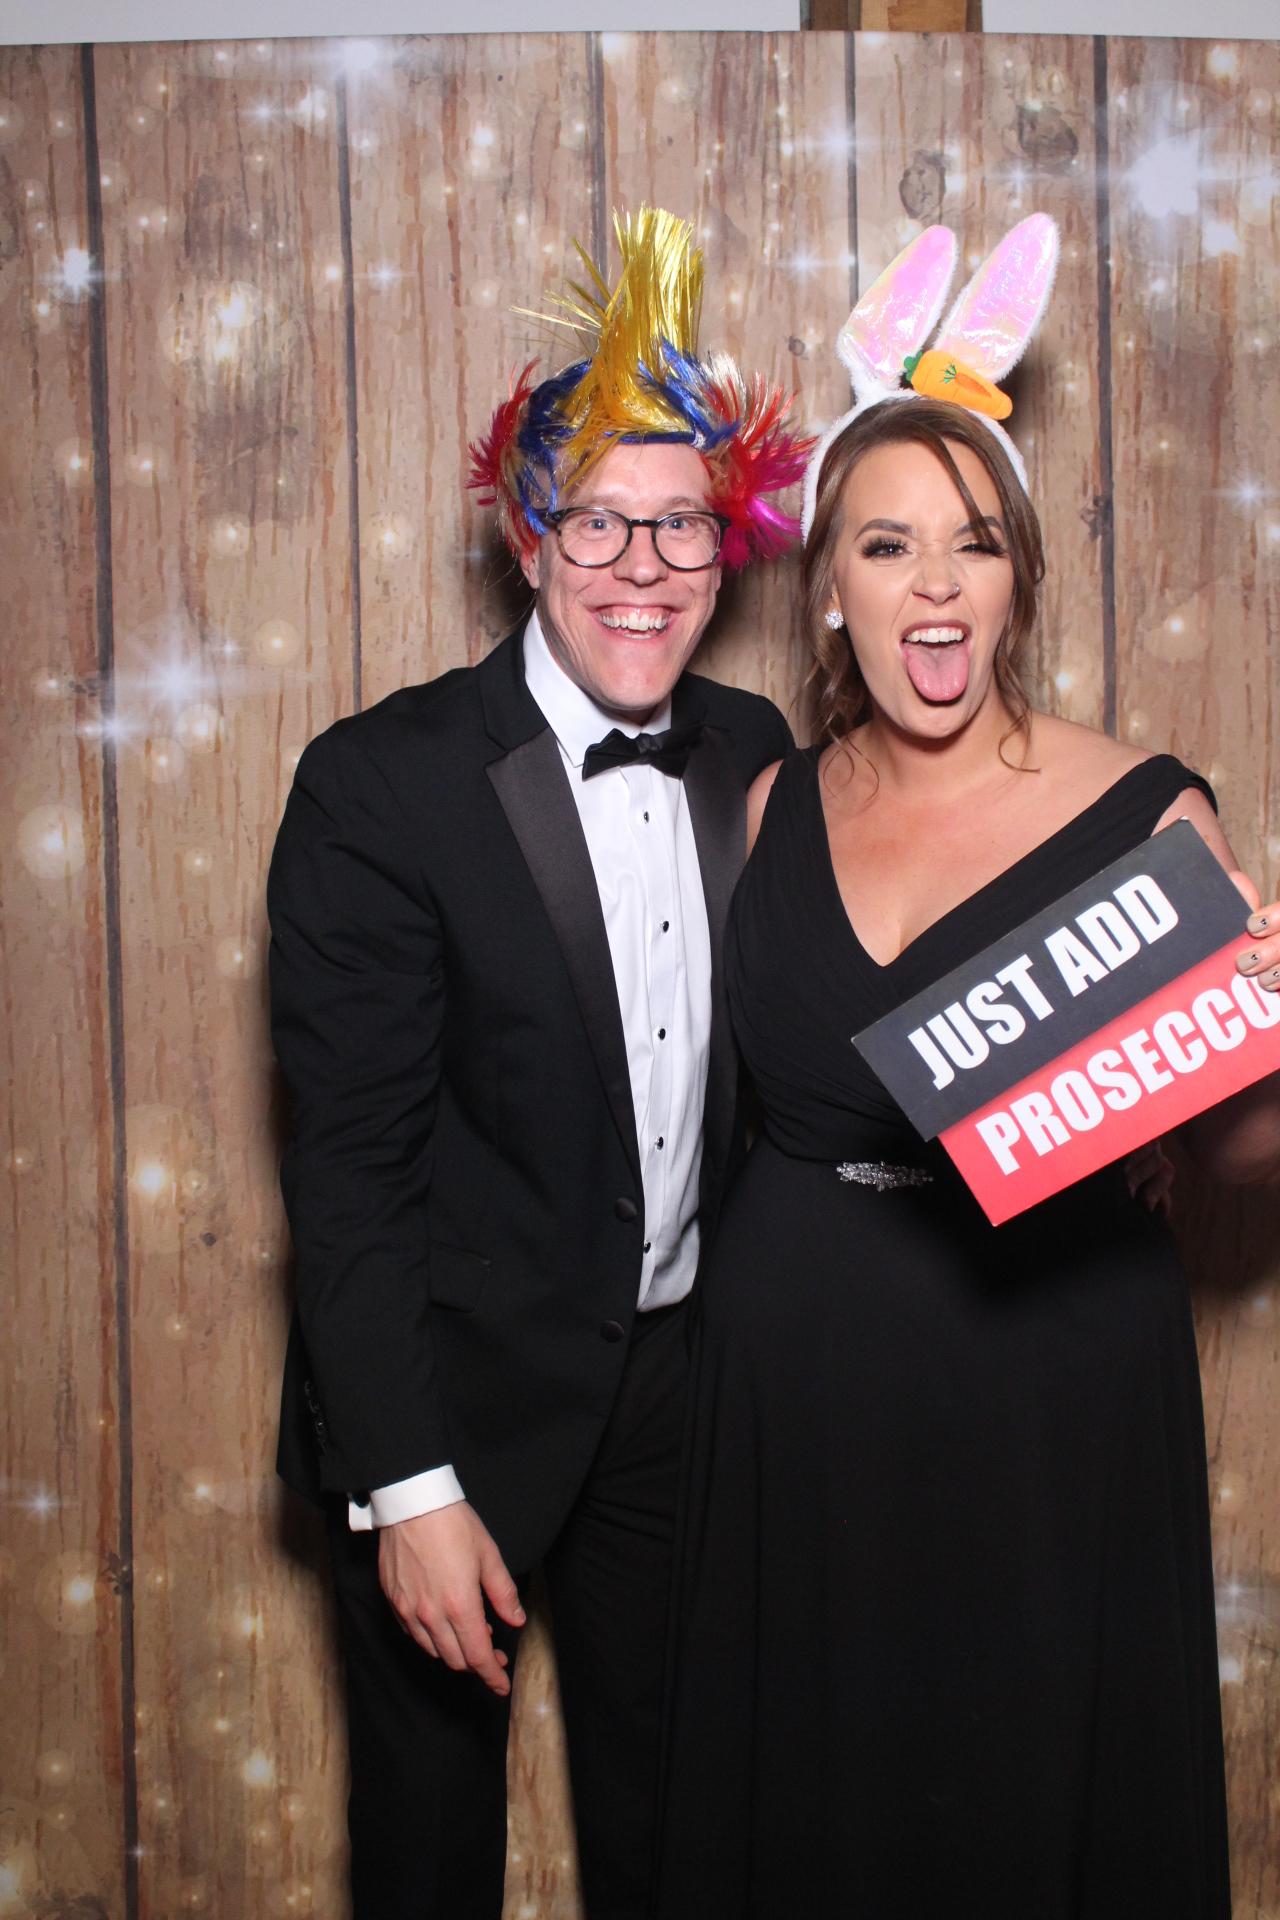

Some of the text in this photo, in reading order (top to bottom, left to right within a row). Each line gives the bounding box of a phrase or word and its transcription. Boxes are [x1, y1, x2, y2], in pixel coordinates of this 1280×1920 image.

[907, 874, 1179, 1091] JUST ADD
[975, 972, 1280, 1176] PROSECCO
